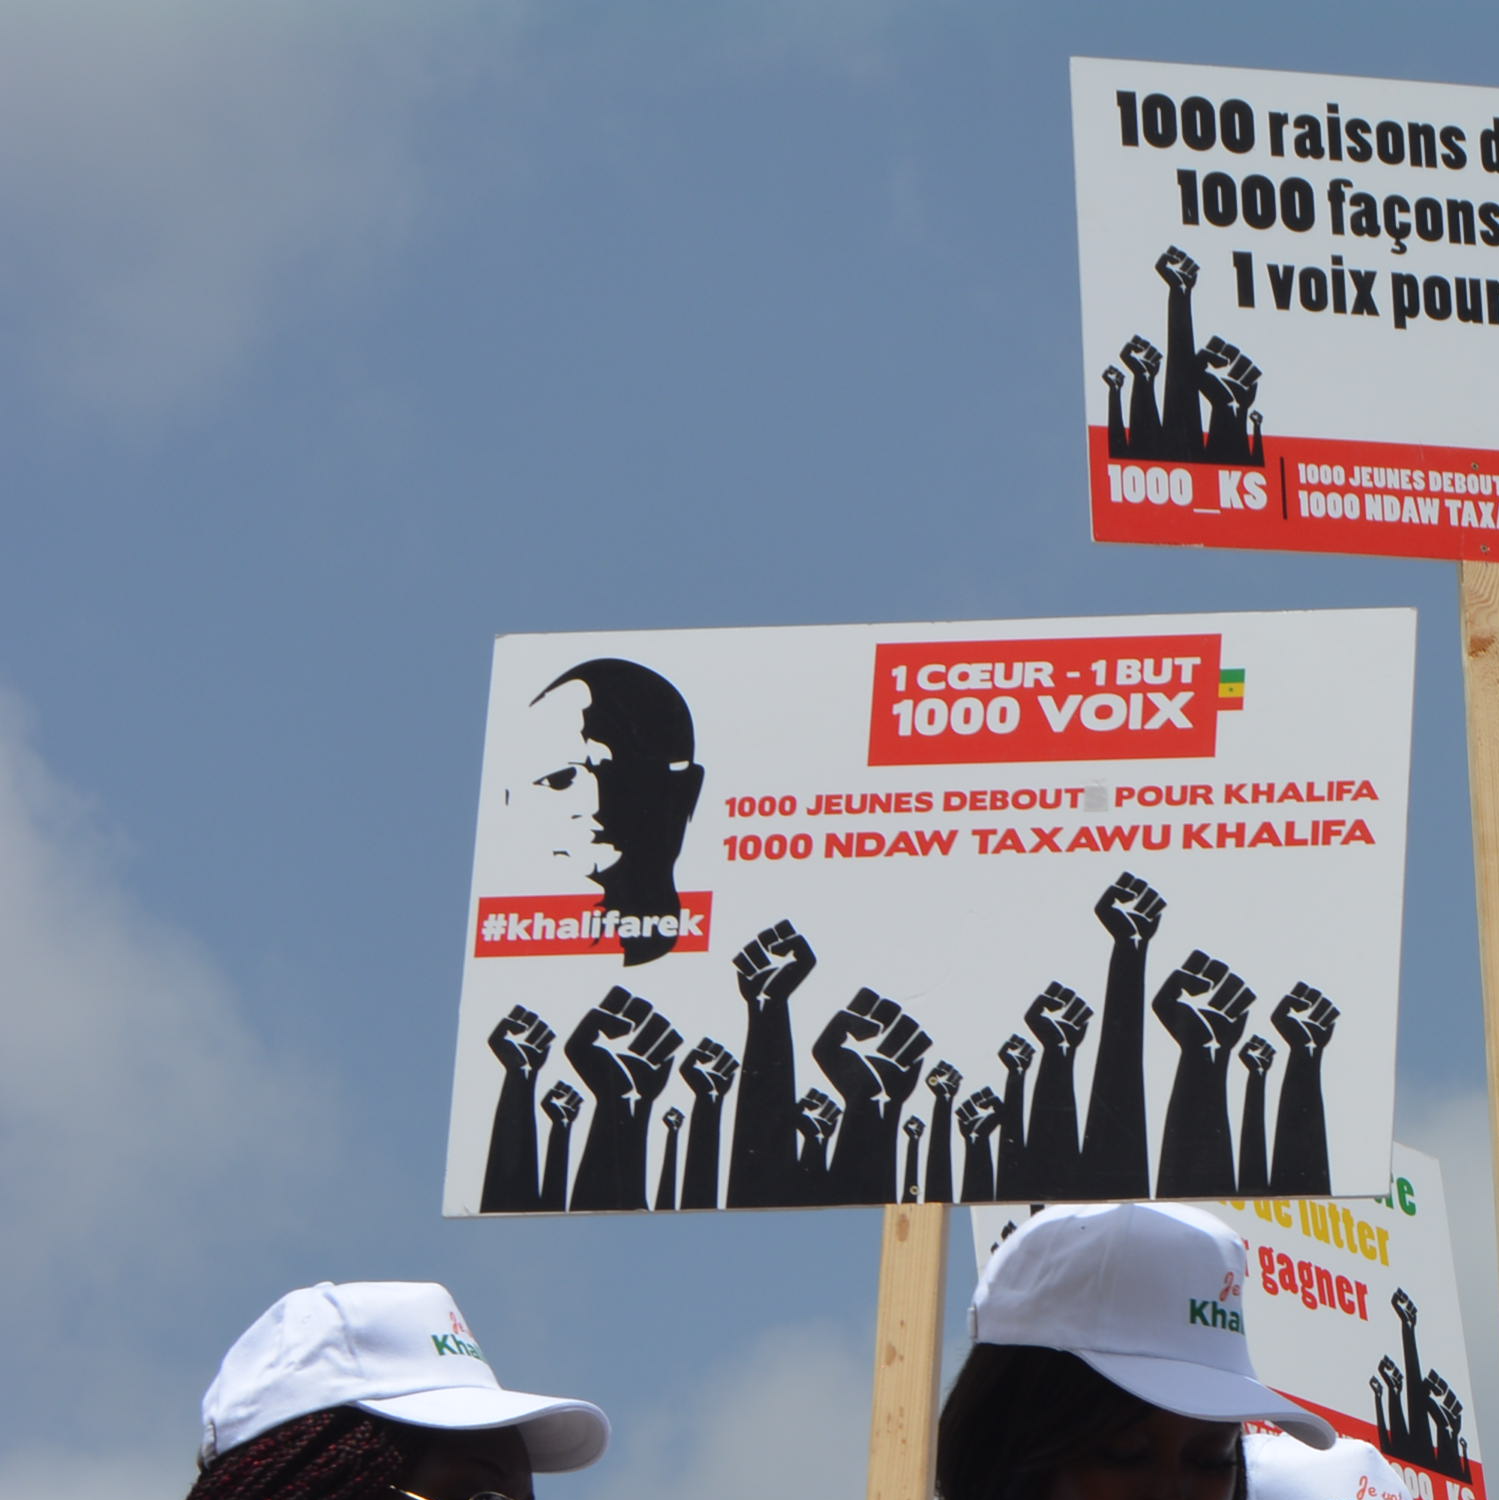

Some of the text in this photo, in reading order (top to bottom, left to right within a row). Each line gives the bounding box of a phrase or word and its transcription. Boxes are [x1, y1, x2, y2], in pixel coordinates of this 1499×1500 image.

[1117, 91, 1254, 153] 1000
[1269, 104, 1466, 169] raisons
[1178, 170, 1314, 231] 1000
[1233, 252, 1254, 307] 1
[1268, 256, 1379, 315] voix
[1108, 464, 1267, 513] 1000_KS
[1299, 464, 1345, 485] 1000
[1350, 467, 1425, 490] JEUNES
[1299, 491, 1360, 519] 1000
[1365, 494, 1440, 525] NDAW
[893, 666, 906, 691] 1
[918, 662, 1054, 690] CŒUR
[1092, 661, 1106, 685] 1
[1117, 658, 1201, 685] BUT
[893, 692, 1194, 736] 1000 VOIX
[726, 796, 796, 817] 1000
[807, 793, 933, 816] JEUNES
[1115, 785, 1213, 807] POUR
[1224, 781, 1378, 804] KHALIFA
[724, 820, 1375, 860] 1000 NDAW TAXAWU KHALIFA
[482, 906, 703, 943] #khalifarek
[1259, 1248, 1367, 1320] gagner
